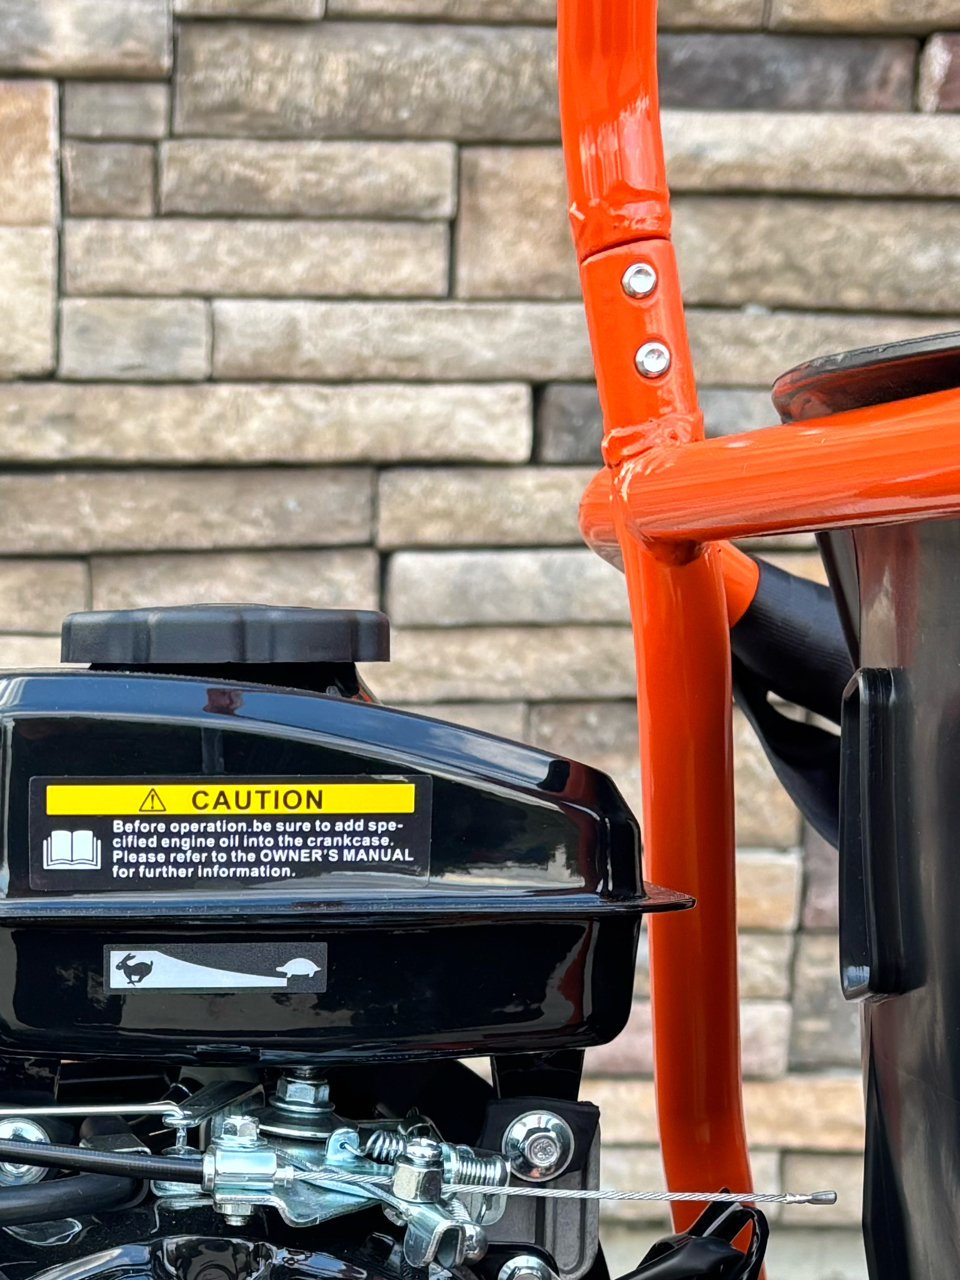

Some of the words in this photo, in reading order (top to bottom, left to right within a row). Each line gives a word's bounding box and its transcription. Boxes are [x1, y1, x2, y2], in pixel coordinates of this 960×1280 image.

[191, 789, 323, 811] CAUTION
[112, 820, 166, 833] Before
[275, 821, 312, 832] sure
[315, 819, 331, 832] to
[334, 819, 365, 832] add
[367, 820, 404, 834] spe-
[112, 835, 157, 848] cified
[161, 834, 215, 850] engine
[219, 835, 239, 848] oil
[243, 834, 274, 848] into
[277, 834, 303, 847] the
[306, 833, 394, 847] crankcase.
[112, 850, 166, 863] Please
[169, 850, 208, 863] refer
[211, 850, 227, 863] to
[230, 850, 256, 863] the
[259, 848, 339, 863] OWNER'S
[342, 848, 414, 862] MANUAL
[111, 865, 135, 878] for
[138, 865, 194, 878] further
[197, 864, 296, 878] information.
